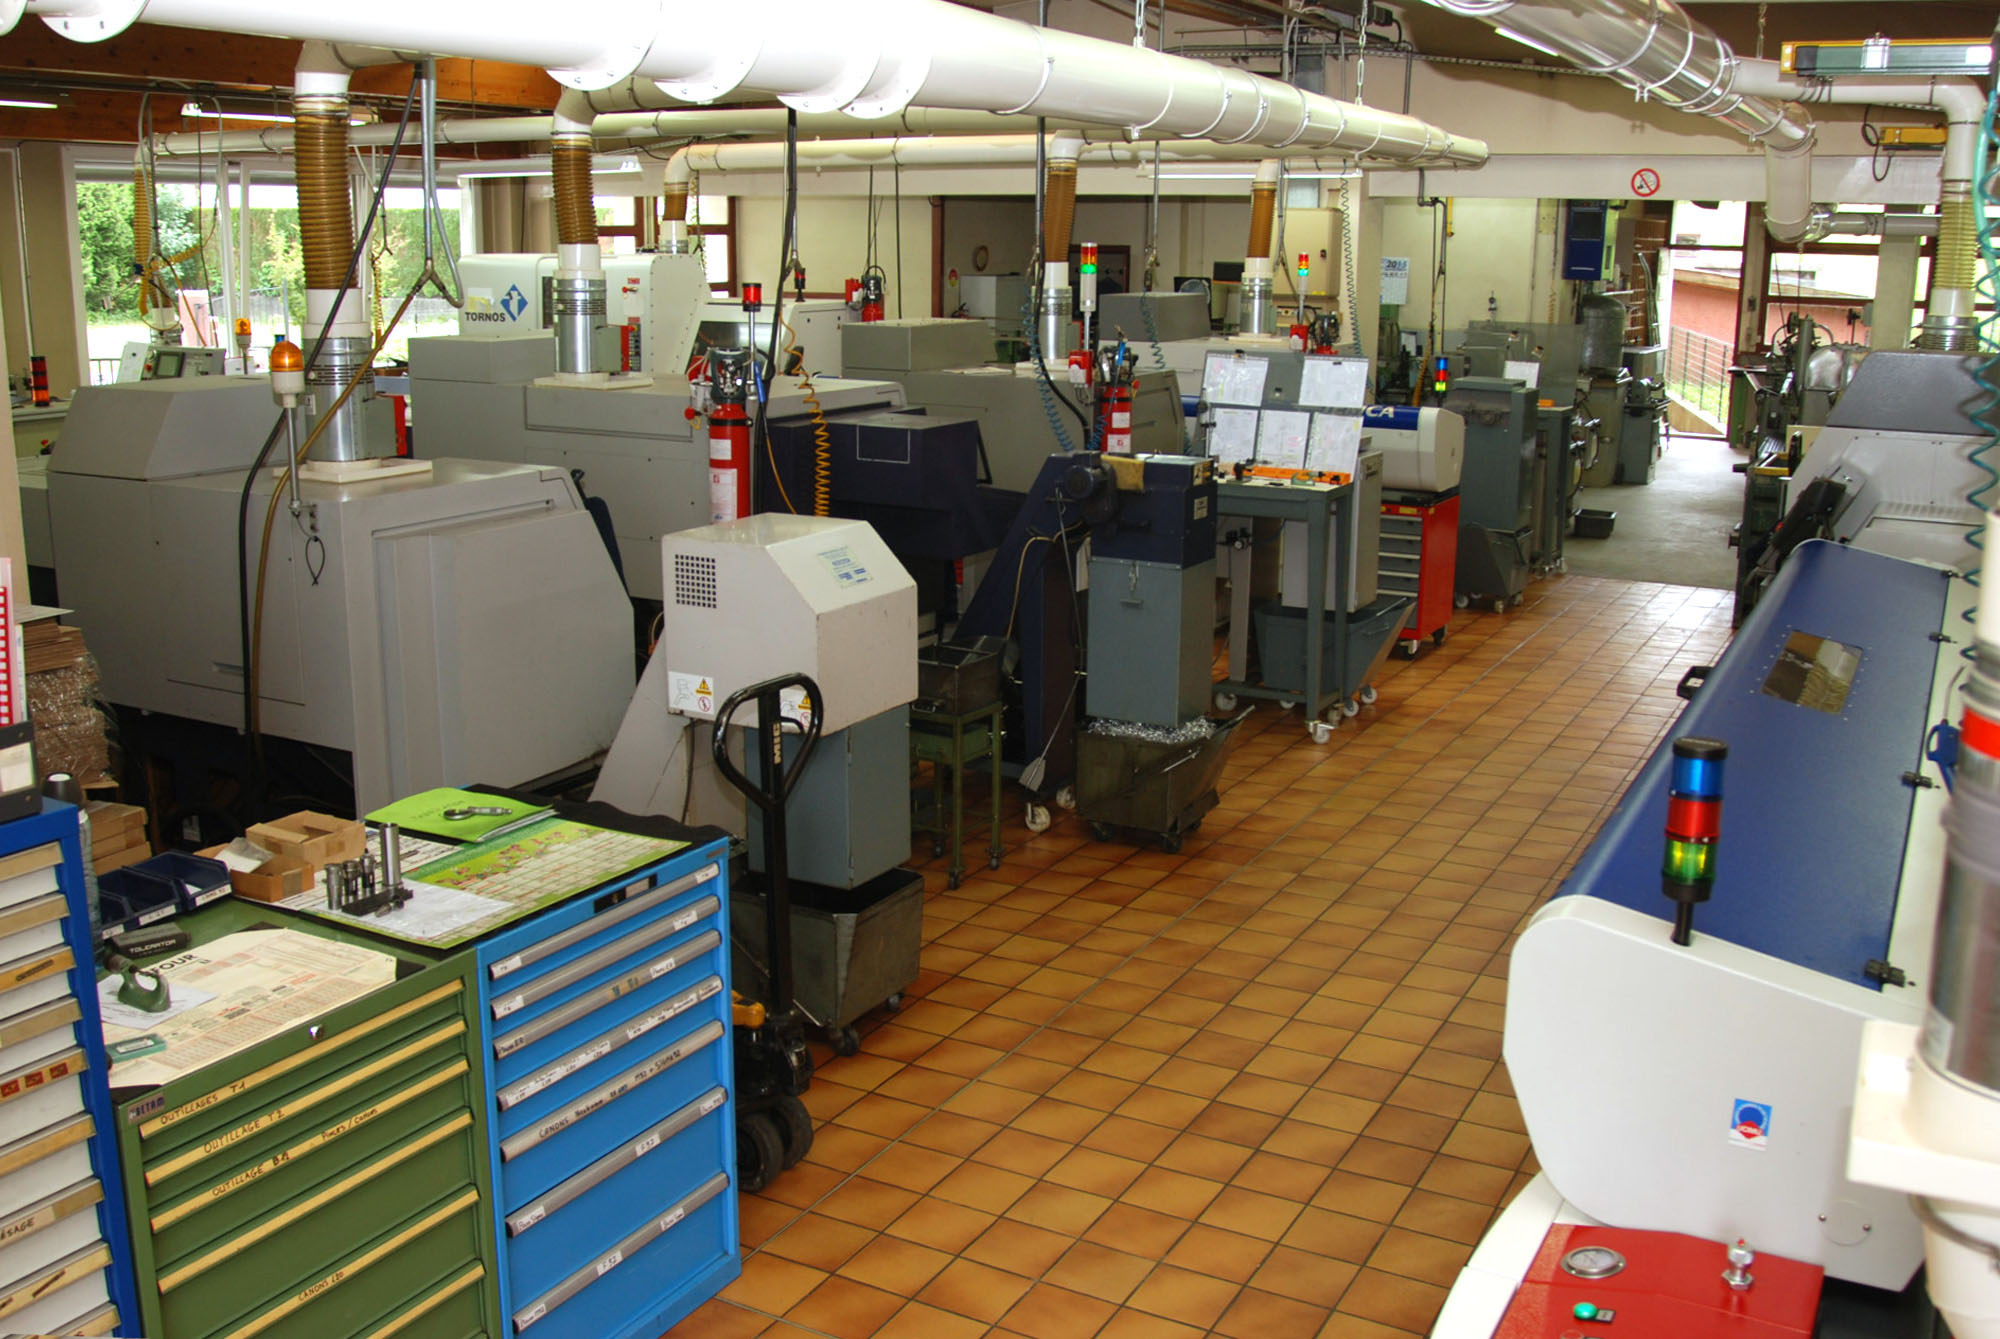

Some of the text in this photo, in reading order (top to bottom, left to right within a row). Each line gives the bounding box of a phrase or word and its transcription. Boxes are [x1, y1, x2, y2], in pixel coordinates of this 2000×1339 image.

[464, 311, 506, 323] TORNOS
[203, 1120, 261, 1154] OUTILLAGE
[212, 1163, 265, 1197] OUTILLAGE
